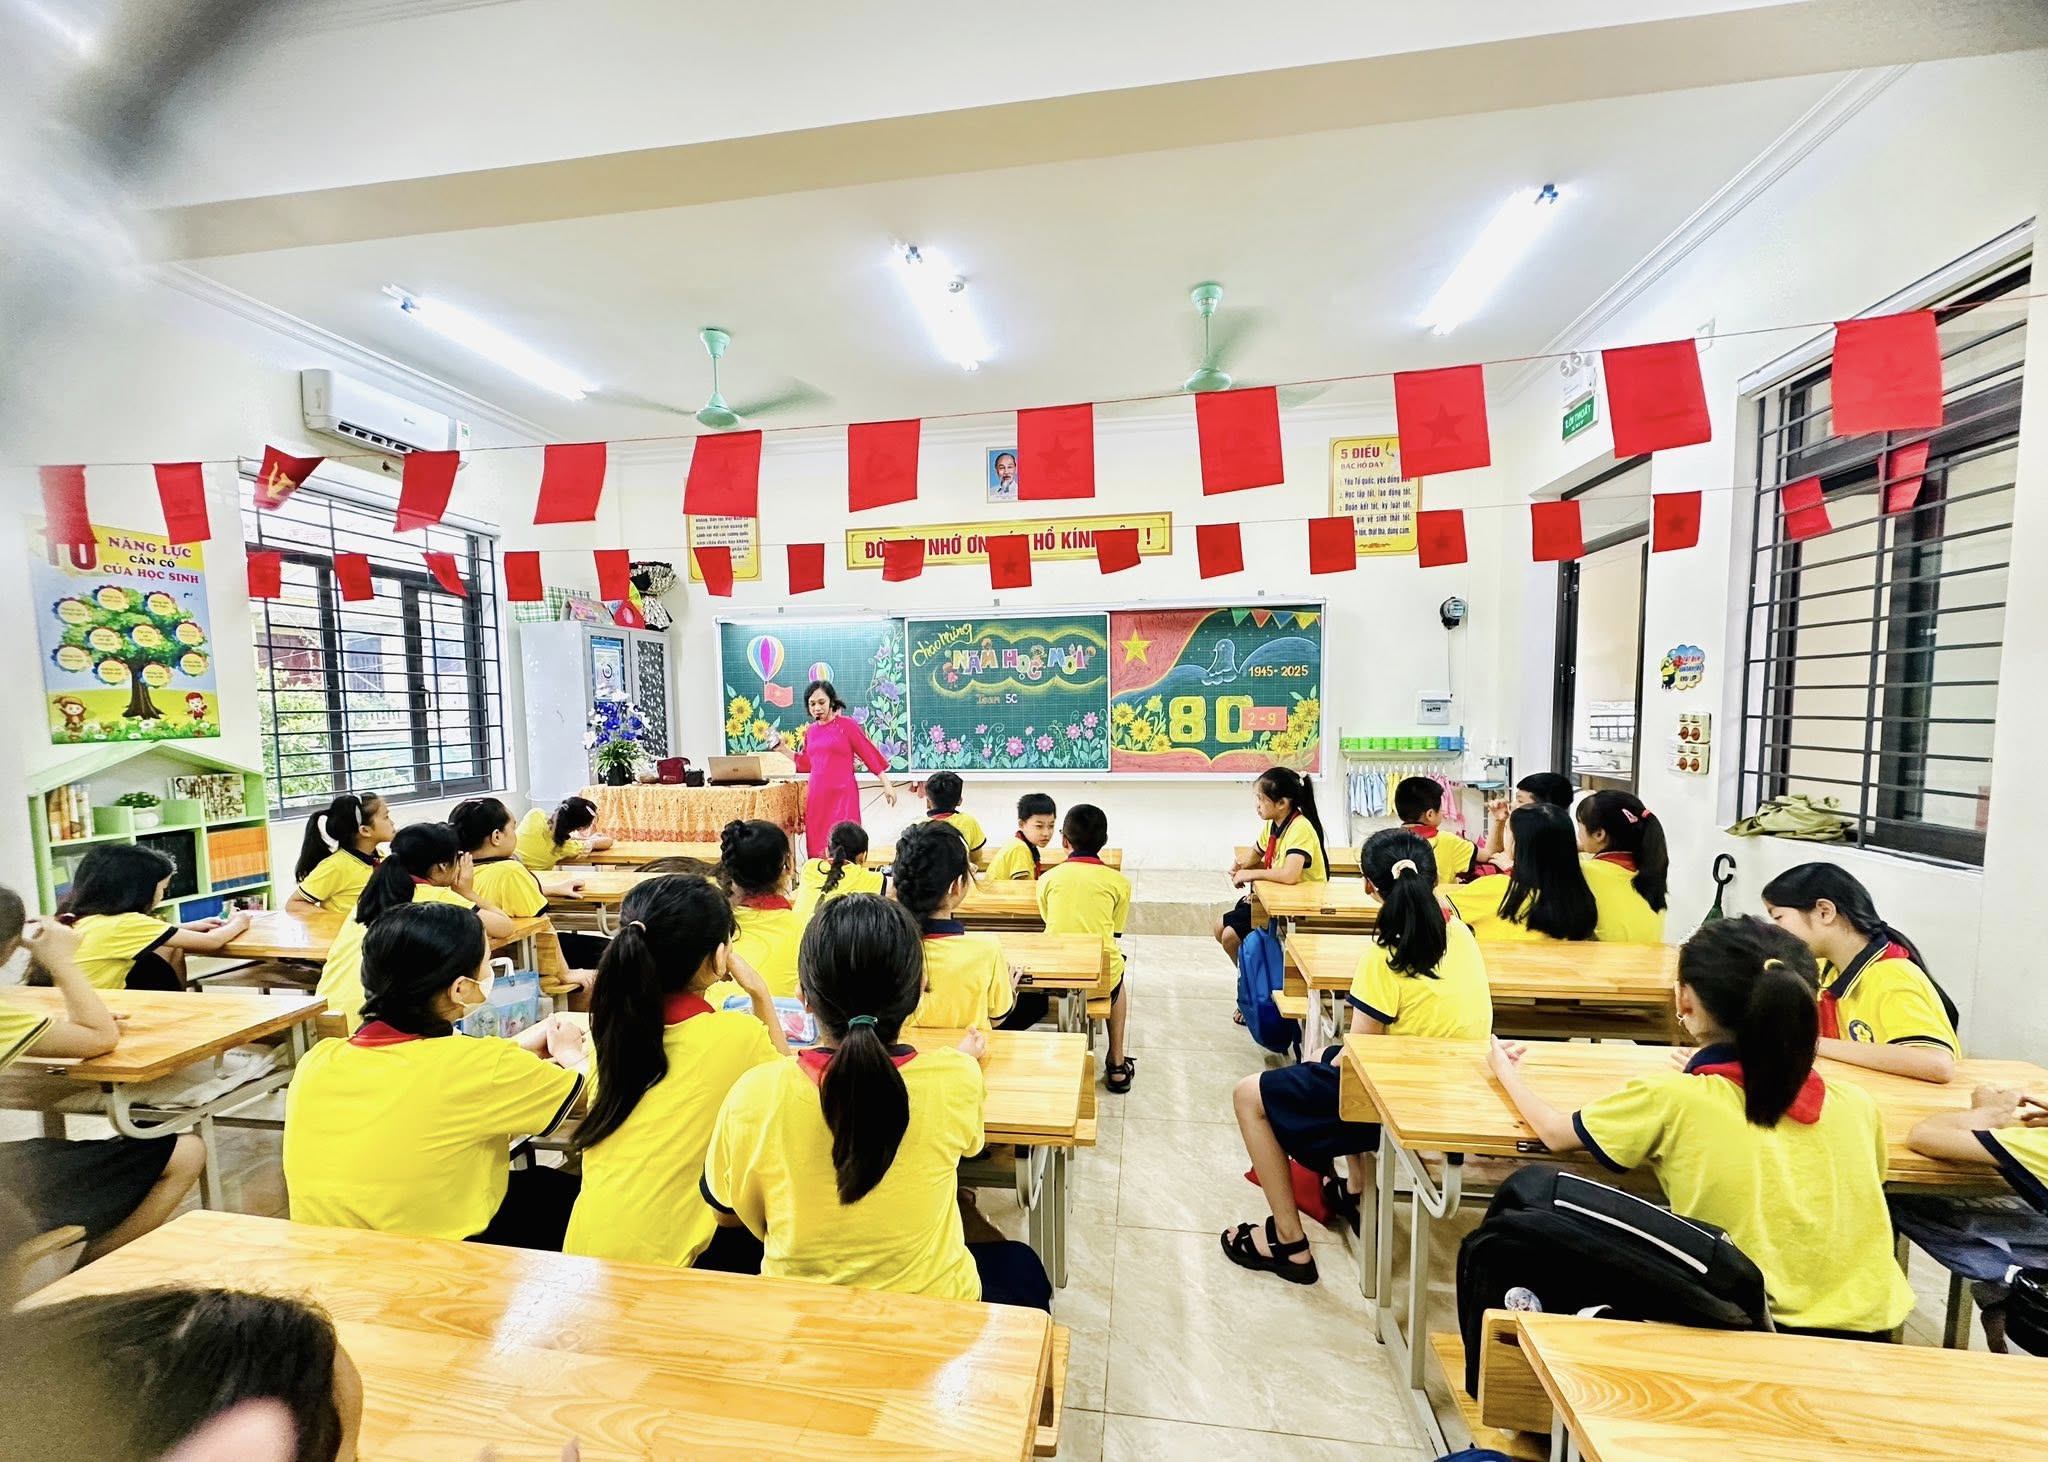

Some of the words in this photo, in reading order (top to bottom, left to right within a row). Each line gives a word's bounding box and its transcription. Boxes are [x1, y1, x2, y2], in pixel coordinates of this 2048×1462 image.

[1341, 449, 1348, 459] 5
[108, 536, 157, 553] NĂNG
[163, 545, 192, 558] LỰC
[865, 537, 886, 558] ĐỜ
[928, 533, 961, 556] NHỚ
[1033, 525, 1056, 551] HỒ
[129, 553, 155, 565] CẦN
[160, 557, 175, 568] CÓ
[103, 562, 132, 576] CỦA
[138, 569, 165, 581] HỌC
[169, 574, 199, 584] SINH
[953, 649, 998, 675] NĂM
[1002, 648, 1042, 680] HỌC
[1005, 693, 1018, 704] 5C
[1169, 695, 1254, 743] 80
